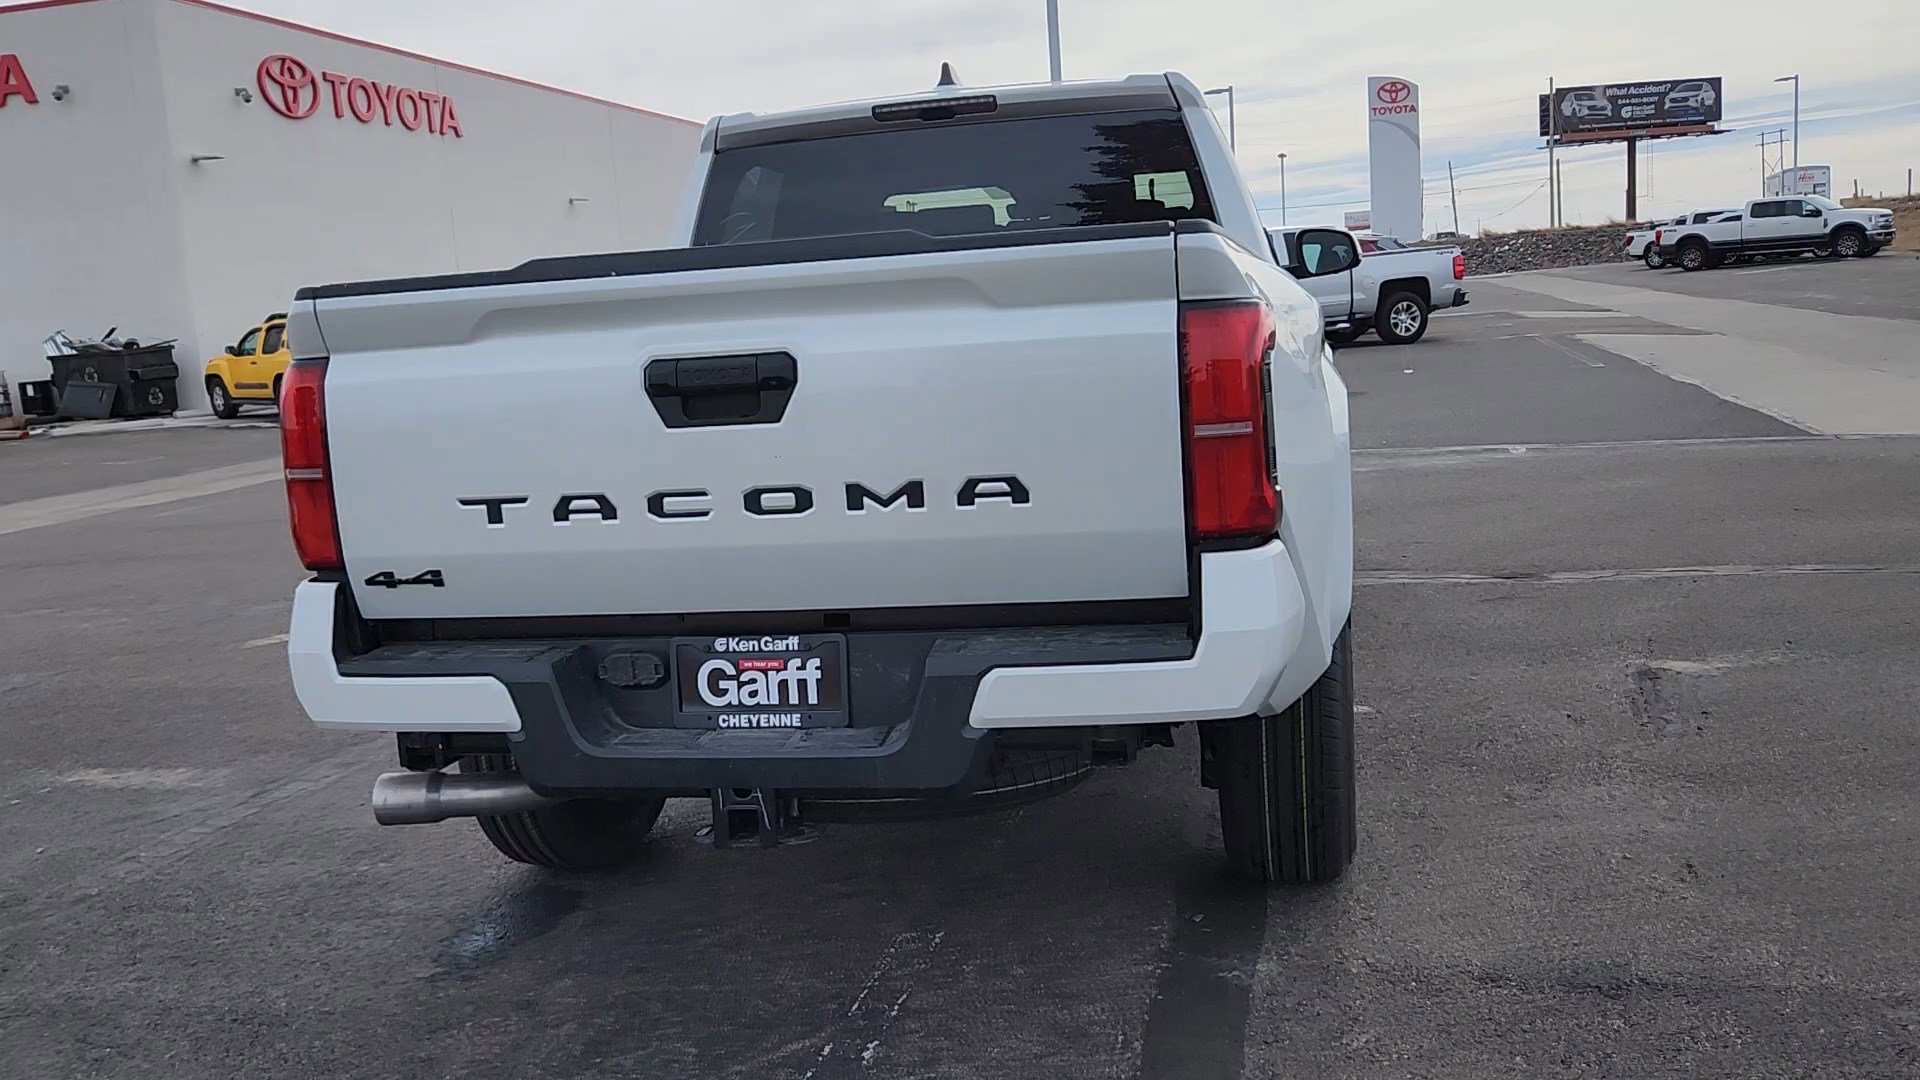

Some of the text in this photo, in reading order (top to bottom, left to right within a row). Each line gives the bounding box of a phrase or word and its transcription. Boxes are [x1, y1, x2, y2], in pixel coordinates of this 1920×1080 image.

[1605, 83, 1671, 96] What Accident?
[322, 71, 464, 138] TOYOTA
[1371, 104, 1417, 116] TOYOTA
[456, 473, 1032, 528] TACOMA
[729, 637, 759, 652] Ken
[761, 636, 800, 651] Garff
[697, 657, 821, 707] Garff
[718, 713, 801, 727] CHEYENNE
